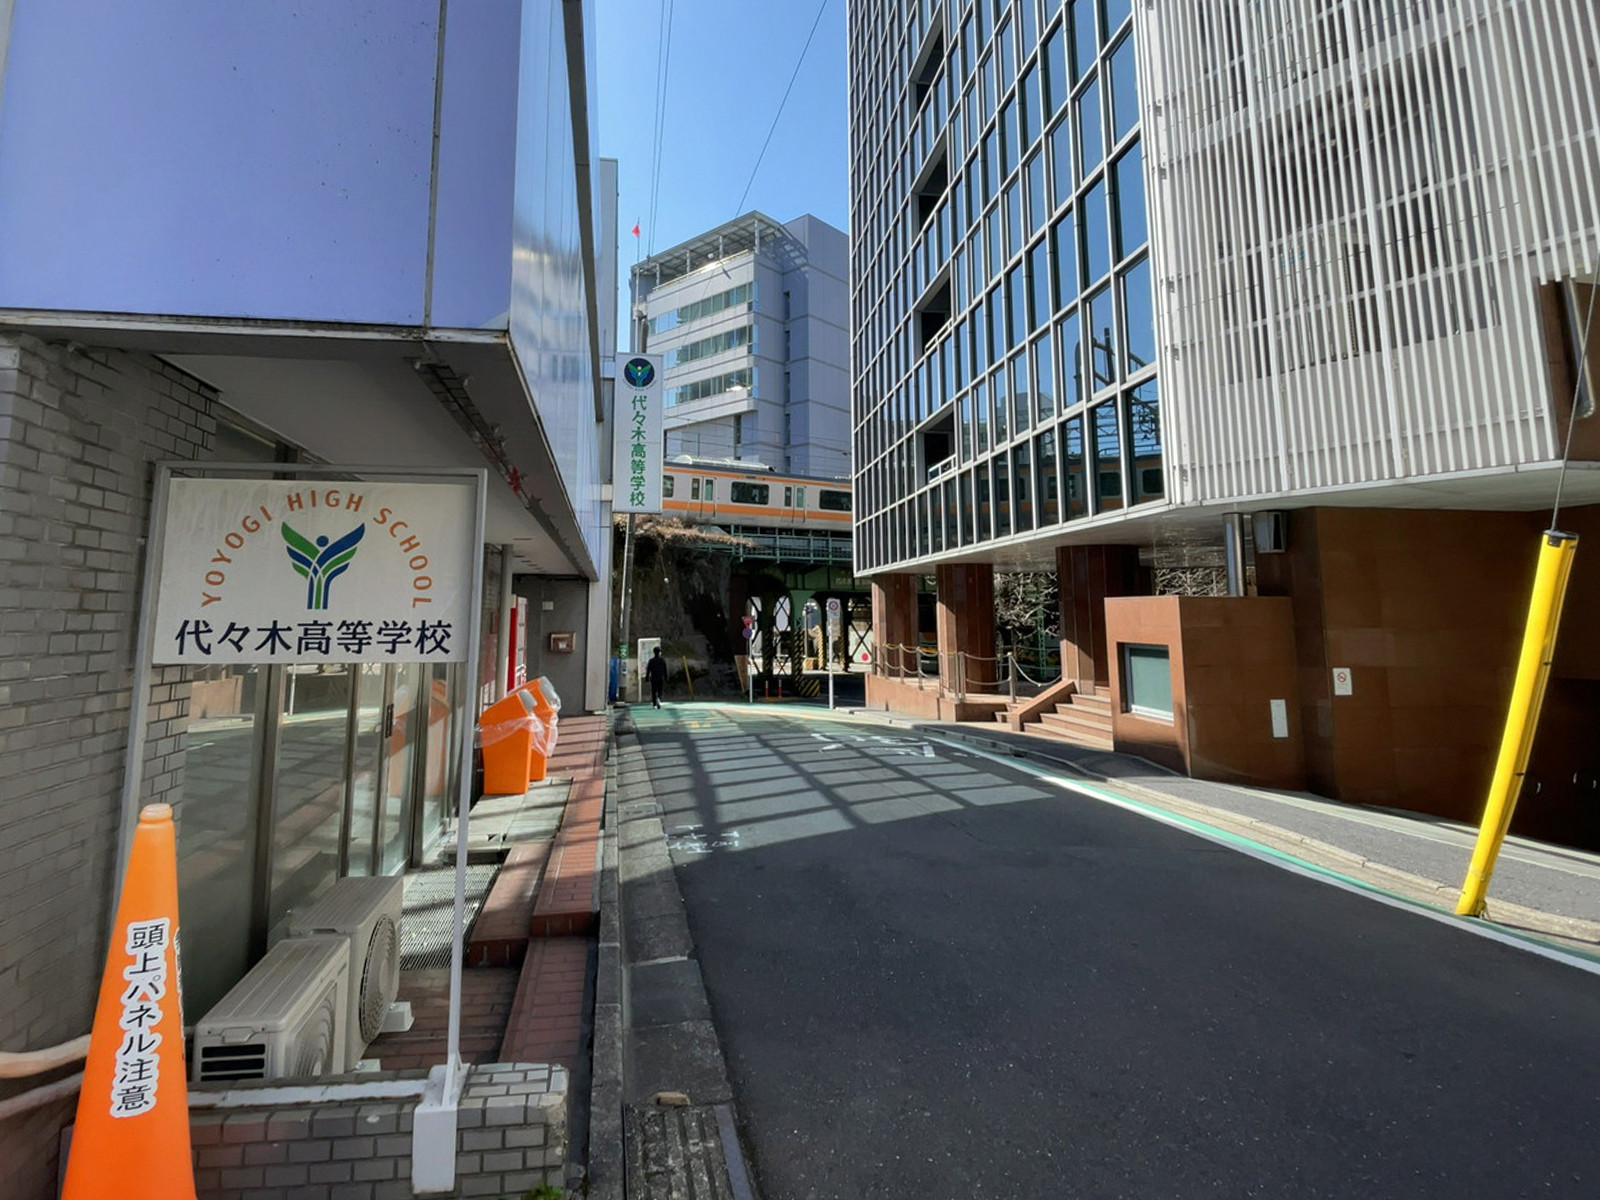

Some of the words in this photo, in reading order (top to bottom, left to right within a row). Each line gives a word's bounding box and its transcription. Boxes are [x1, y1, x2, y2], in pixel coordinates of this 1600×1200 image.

[629, 394, 647, 507] 代々木高等学校
[201, 506, 273, 608] YOYOGI
[286, 488, 364, 514] HIGH
[373, 507, 433, 609] SCHOOL
[174, 619, 453, 656] 代々木高等学校
[116, 921, 167, 1113] 頭上パネル注意
